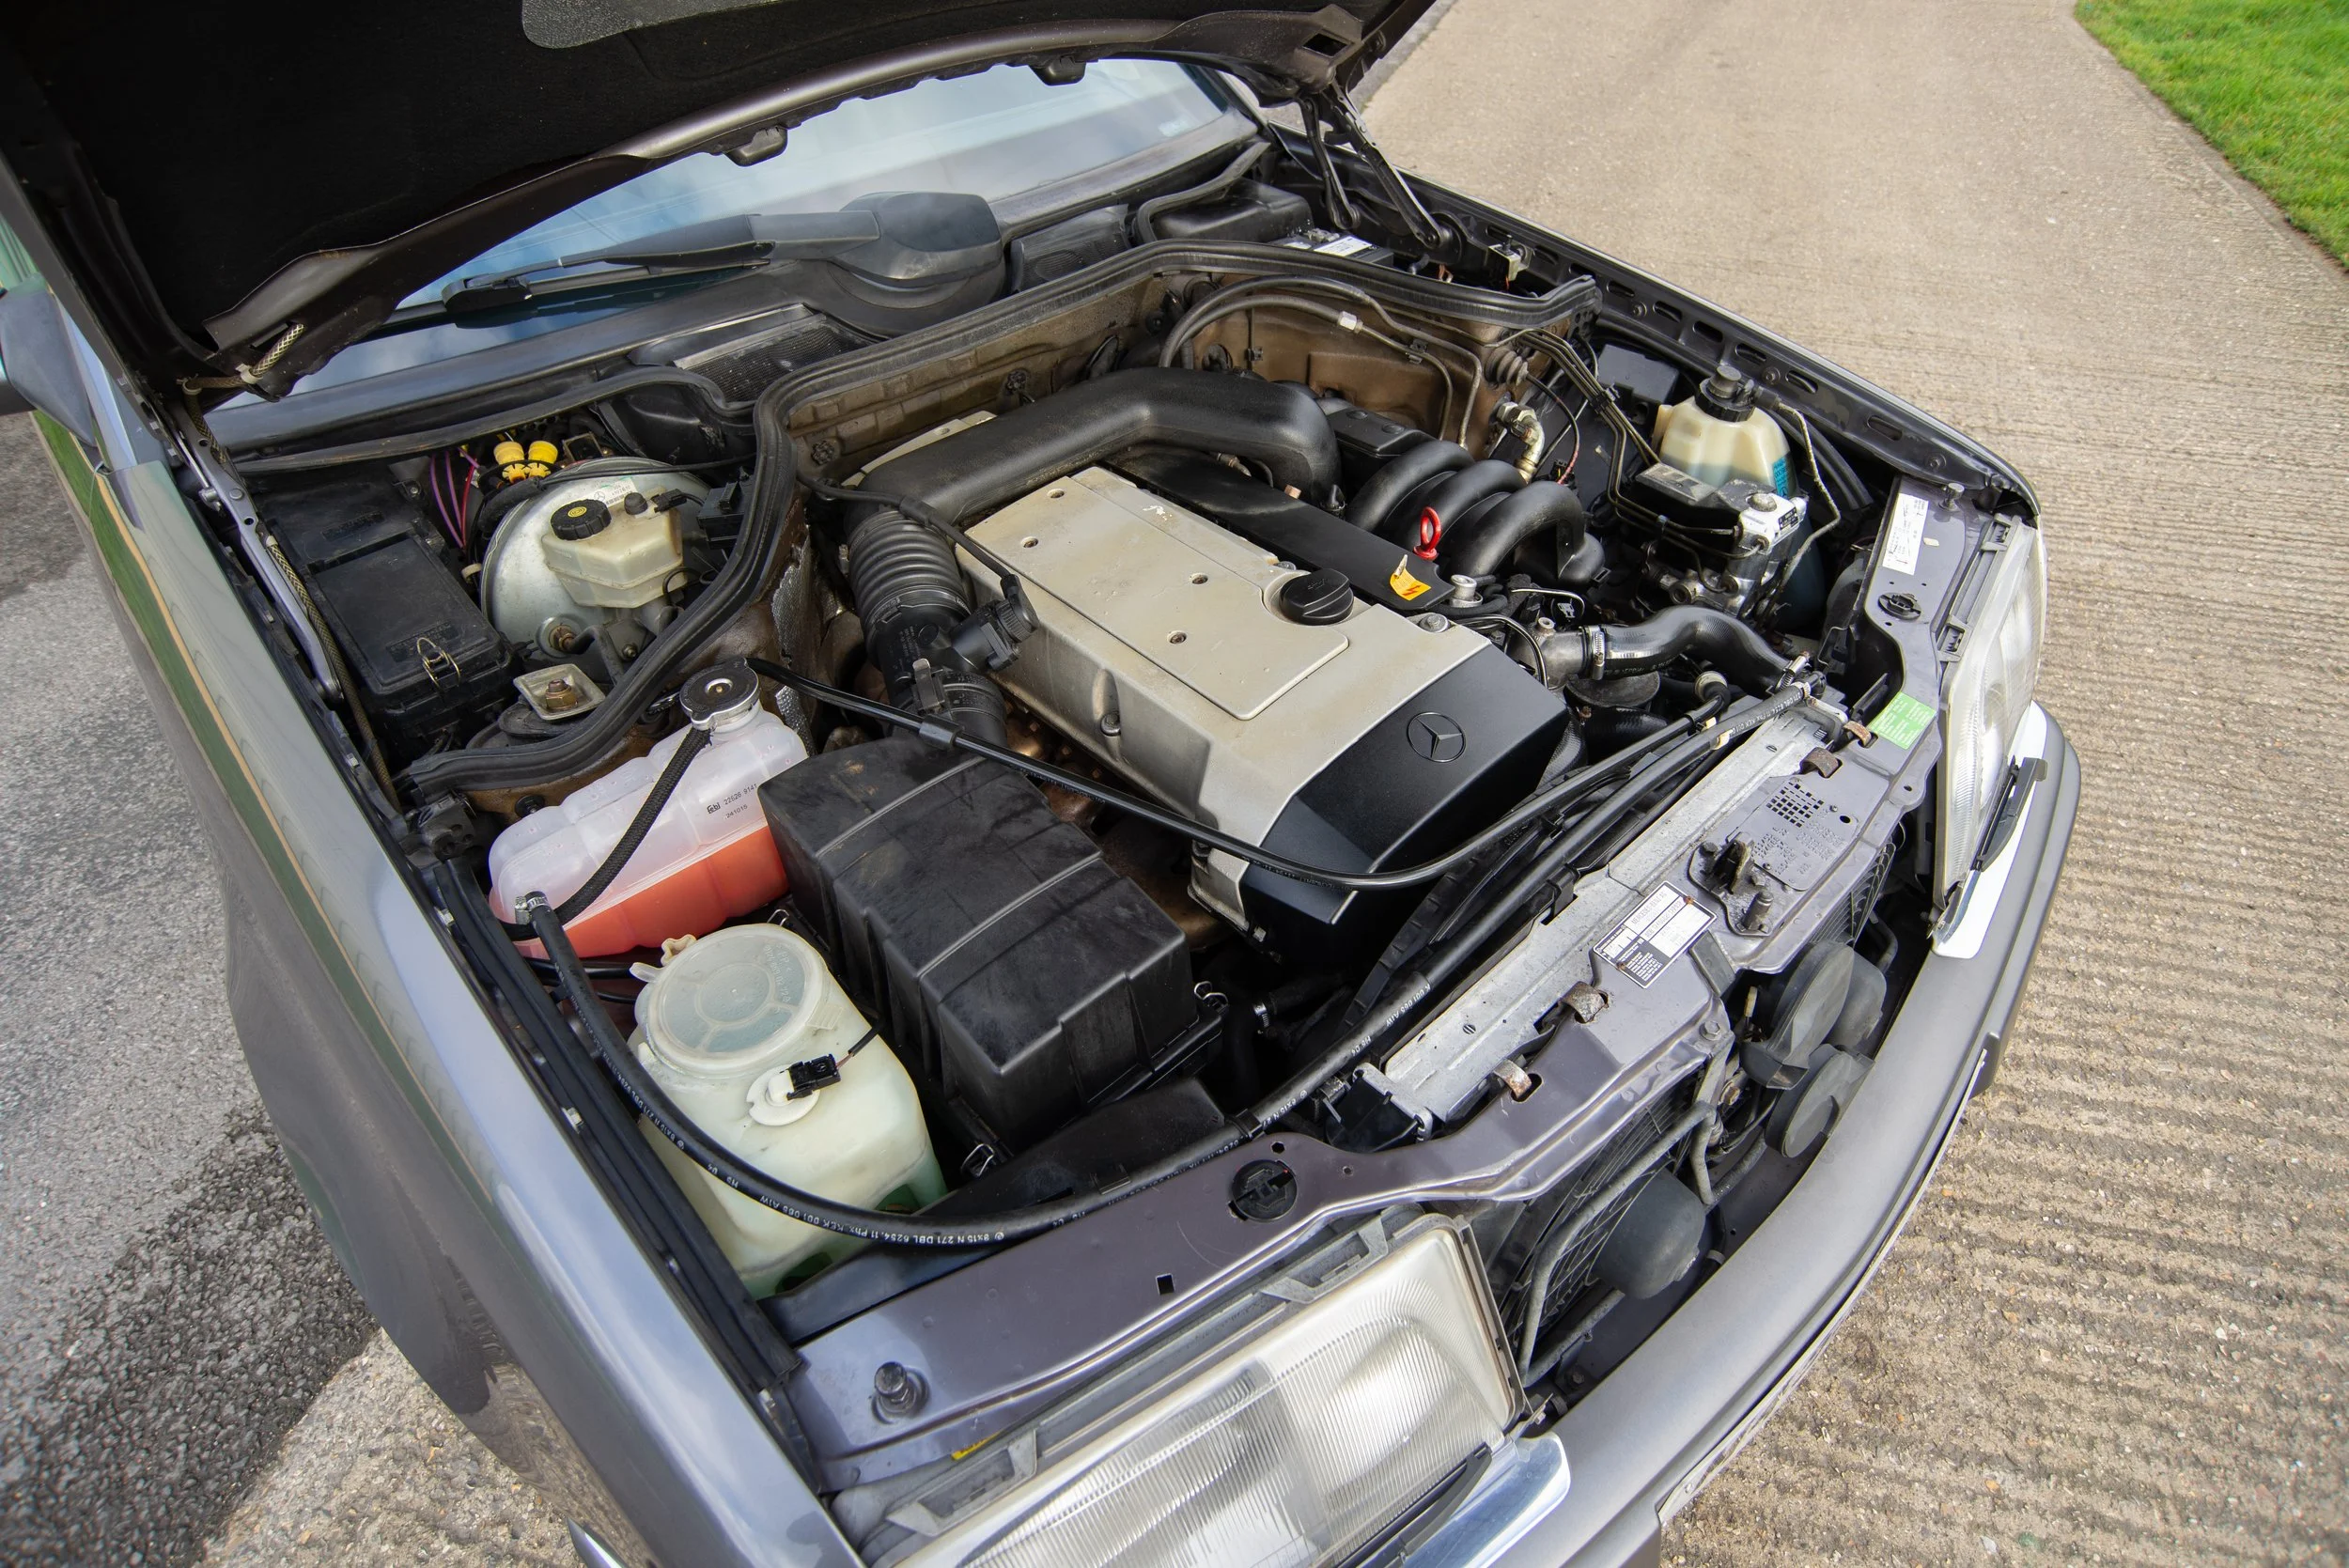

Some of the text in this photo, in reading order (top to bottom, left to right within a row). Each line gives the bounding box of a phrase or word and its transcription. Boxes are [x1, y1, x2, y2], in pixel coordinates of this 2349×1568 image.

[803, 1213, 820, 1225] 001
[822, 1219, 845, 1232] KEK
[912, 1234, 934, 1245] DBL
[937, 1235, 954, 1245] 271
[957, 1235, 964, 1244] N
